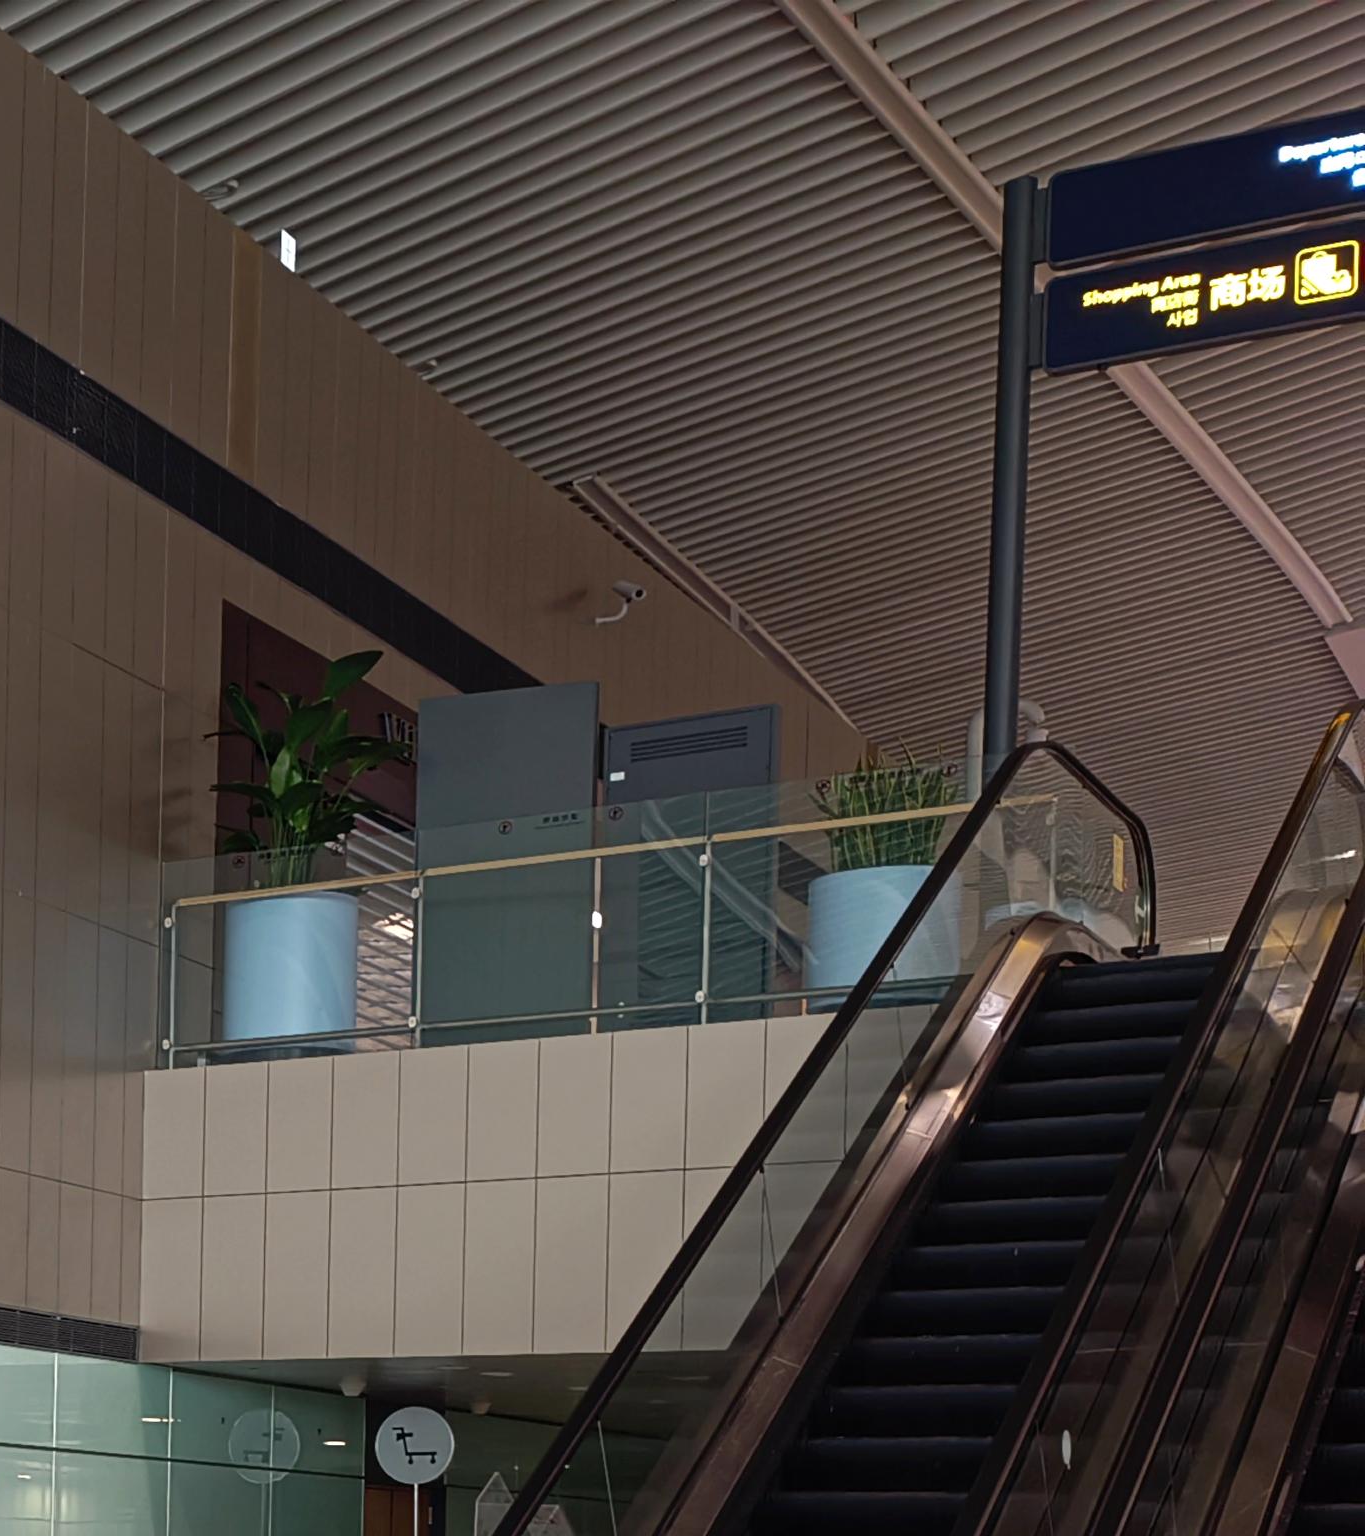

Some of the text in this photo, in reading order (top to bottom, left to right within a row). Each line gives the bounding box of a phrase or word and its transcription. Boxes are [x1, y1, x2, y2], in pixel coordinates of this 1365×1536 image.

[1082, 281, 1159, 307] Shopping
[1160, 273, 1201, 291] Area
[1209, 265, 1286, 311] 商场
